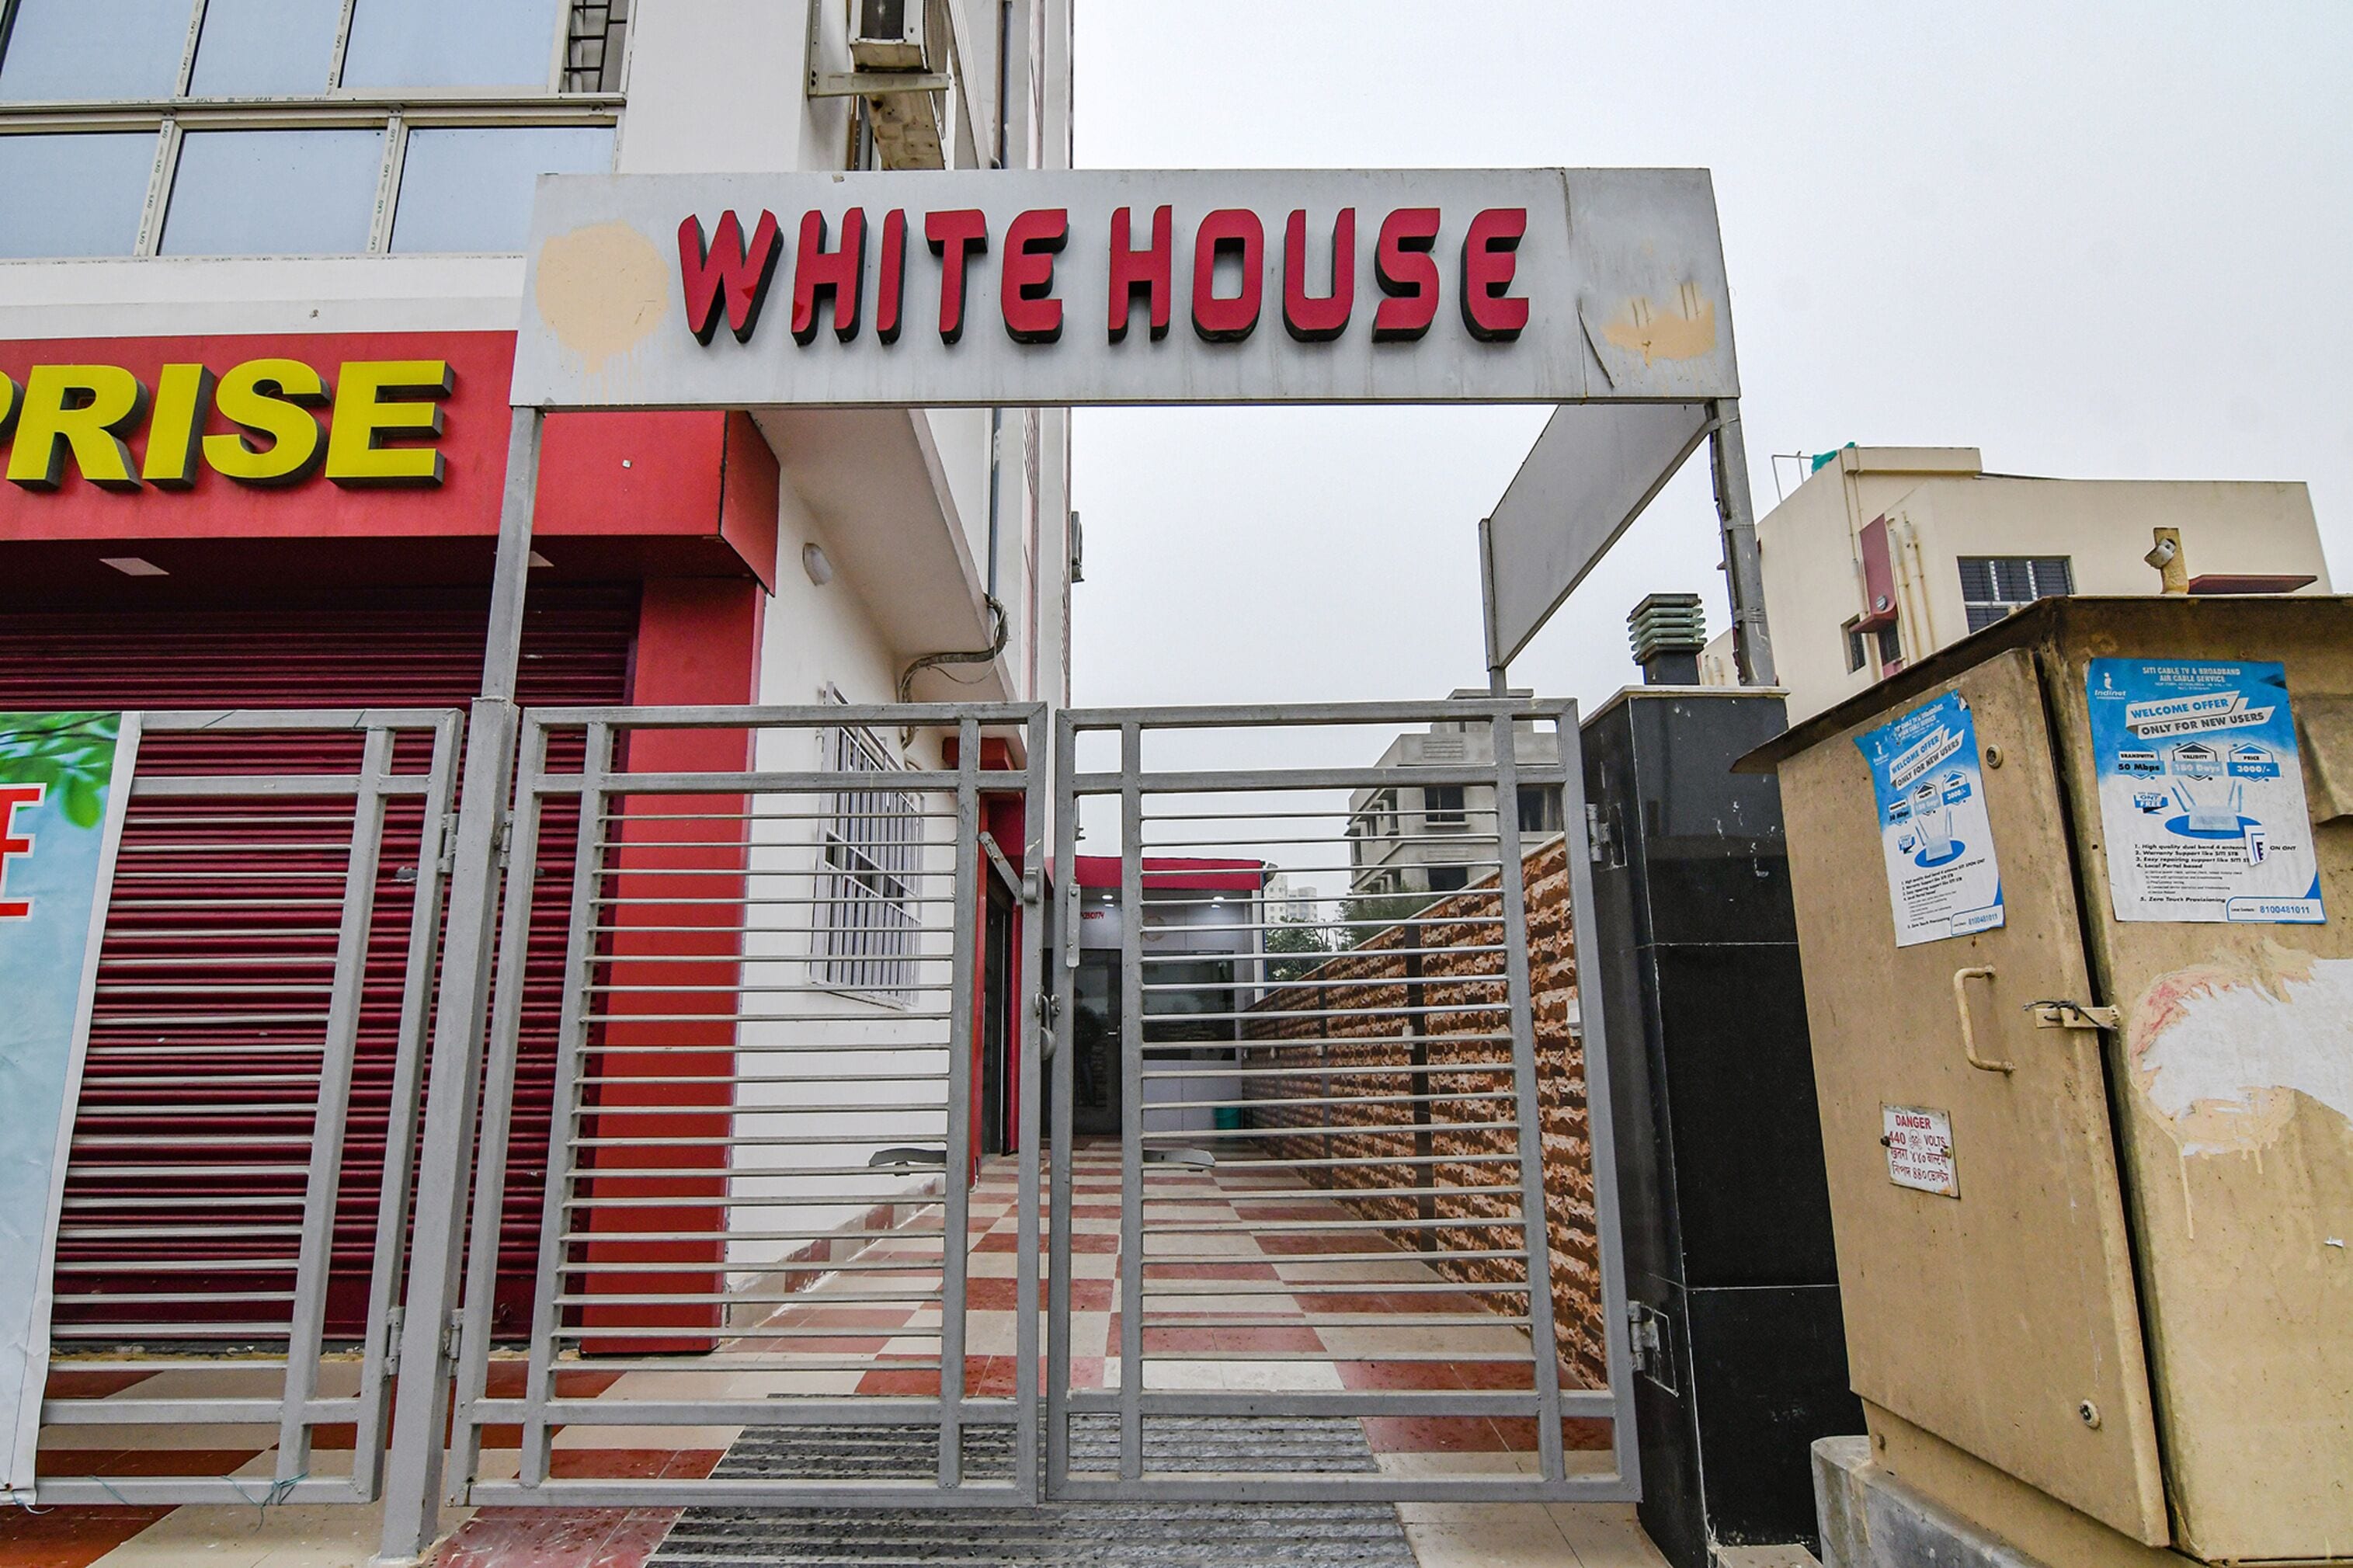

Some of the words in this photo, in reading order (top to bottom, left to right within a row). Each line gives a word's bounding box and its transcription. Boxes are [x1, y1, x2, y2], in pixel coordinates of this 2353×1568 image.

[677, 207, 1069, 344] WHITE
[1108, 206, 1530, 344] HOUSE
[0, 358, 455, 491] RISE
[2131, 704, 2189, 718] WELCOME
[2192, 699, 2229, 711] OFFER
[2141, 724, 2171, 735] ONLY
[2175, 721, 2198, 731] FOR
[2201, 717, 2226, 728] NEW
[2230, 712, 2264, 724] USERS
[1892, 750, 1920, 774] WELCOME
[1920, 735, 1939, 753] OFFER
[1897, 773, 1912, 786] ONLY
[1913, 763, 1925, 775] FOR
[1926, 753, 1939, 767] NEW
[1940, 739, 1960, 756] USERS
[2134, 763, 2160, 772] Mbps
[1896, 1114, 1931, 1129] DANGER
[1889, 1132, 1906, 1145] 440
[1924, 1135, 1945, 1147] VOLTS
